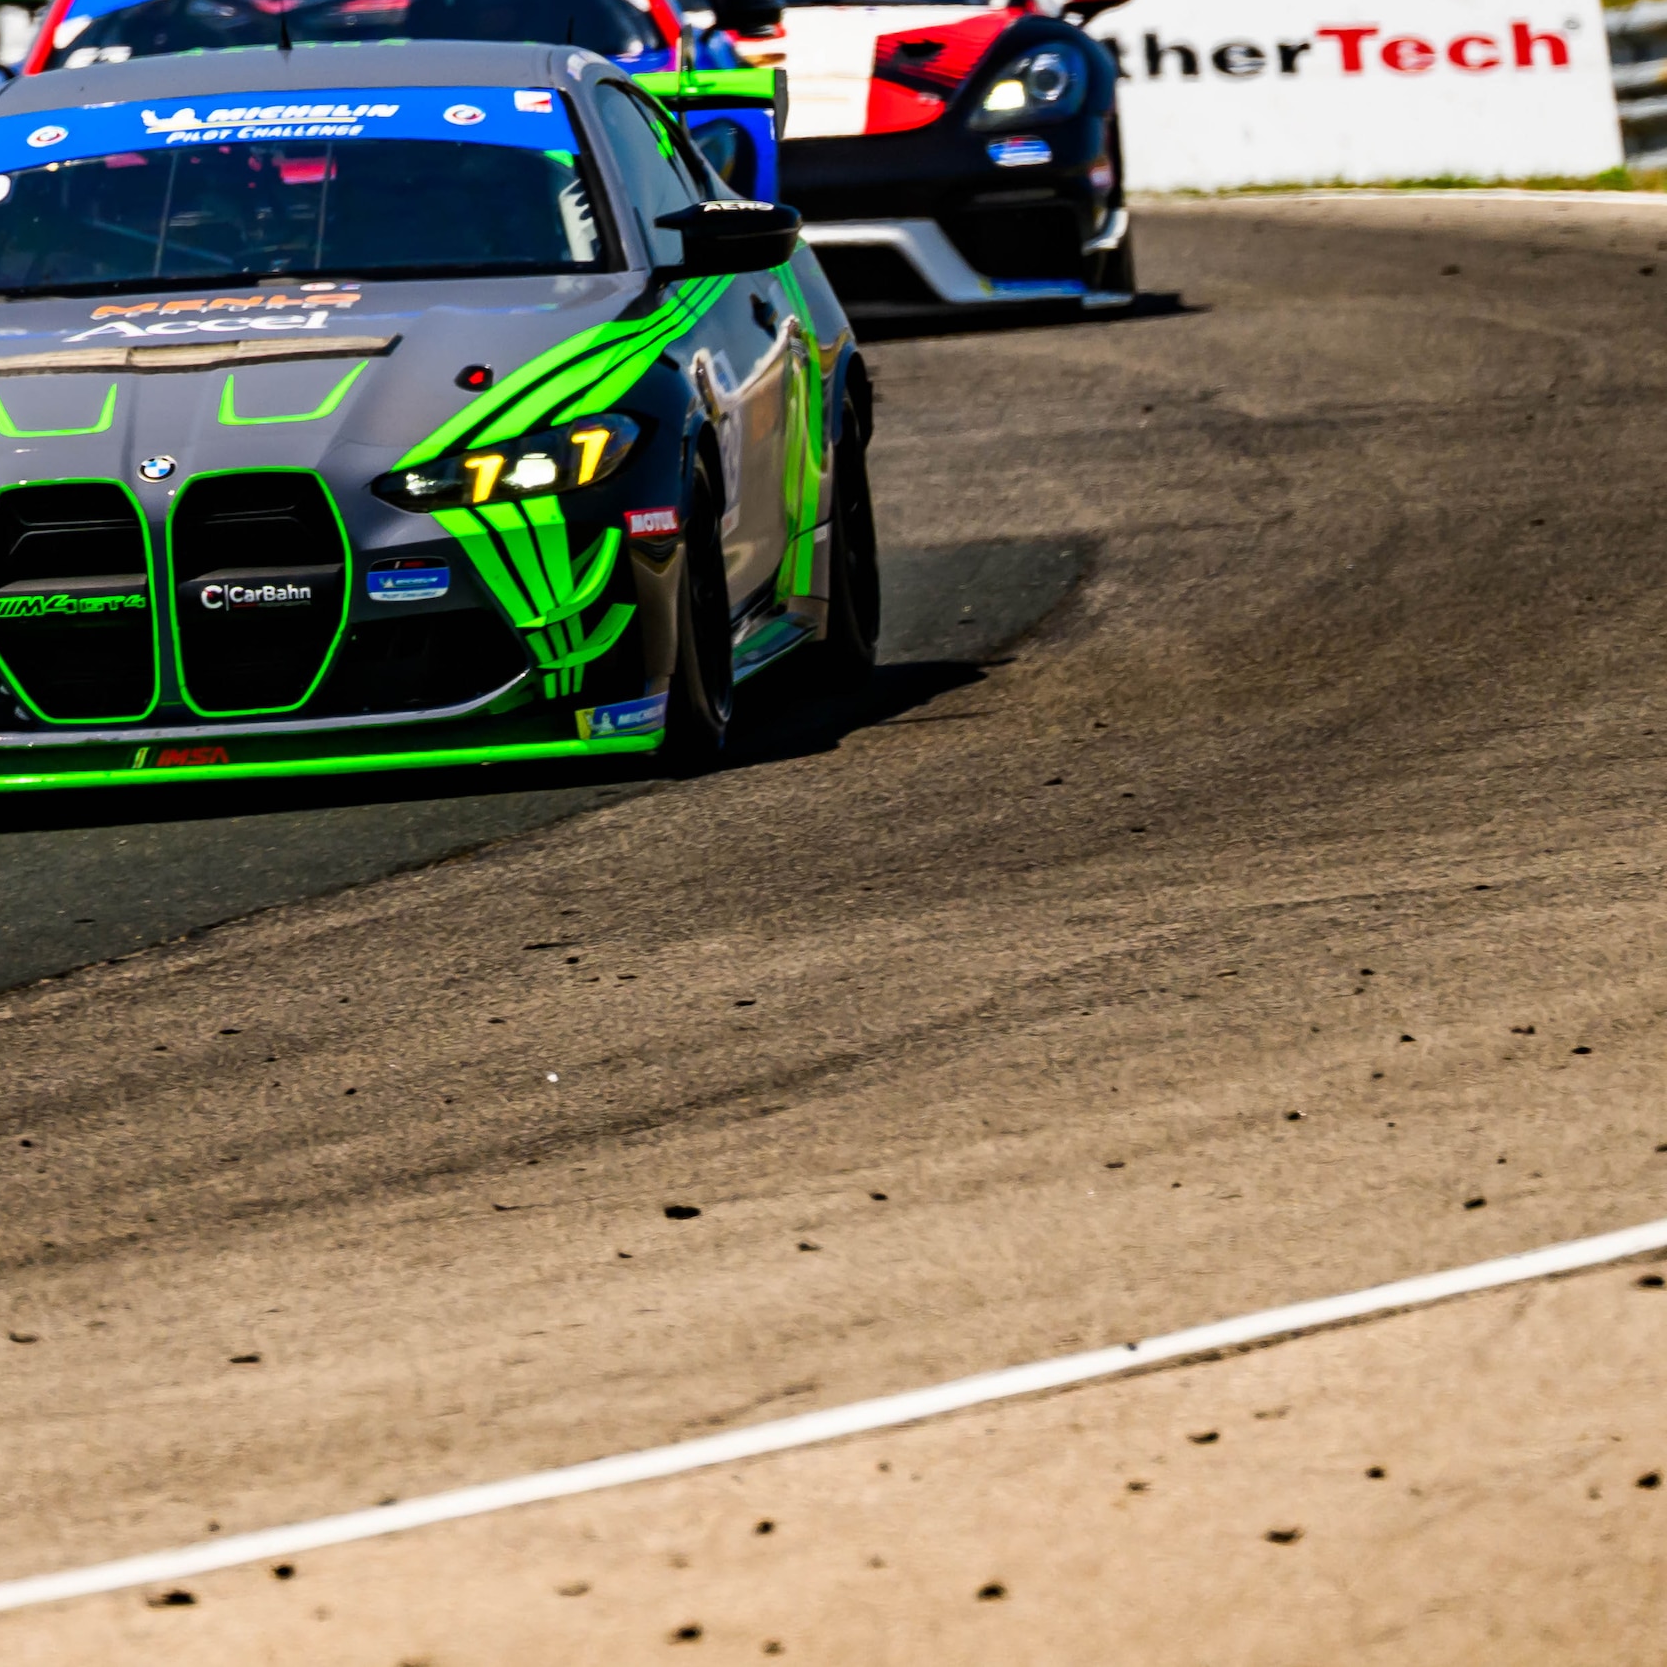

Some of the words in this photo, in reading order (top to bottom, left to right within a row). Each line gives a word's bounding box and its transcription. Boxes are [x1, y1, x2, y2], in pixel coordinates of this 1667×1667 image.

[205, 104, 400, 124] MICHELIN
[165, 129, 234, 145] PILOT
[237, 124, 365, 139] CHALLENGE
[62, 310, 331, 344] Accel
[229, 584, 311, 603] CarBahn
[157, 746, 229, 767] IMSA
